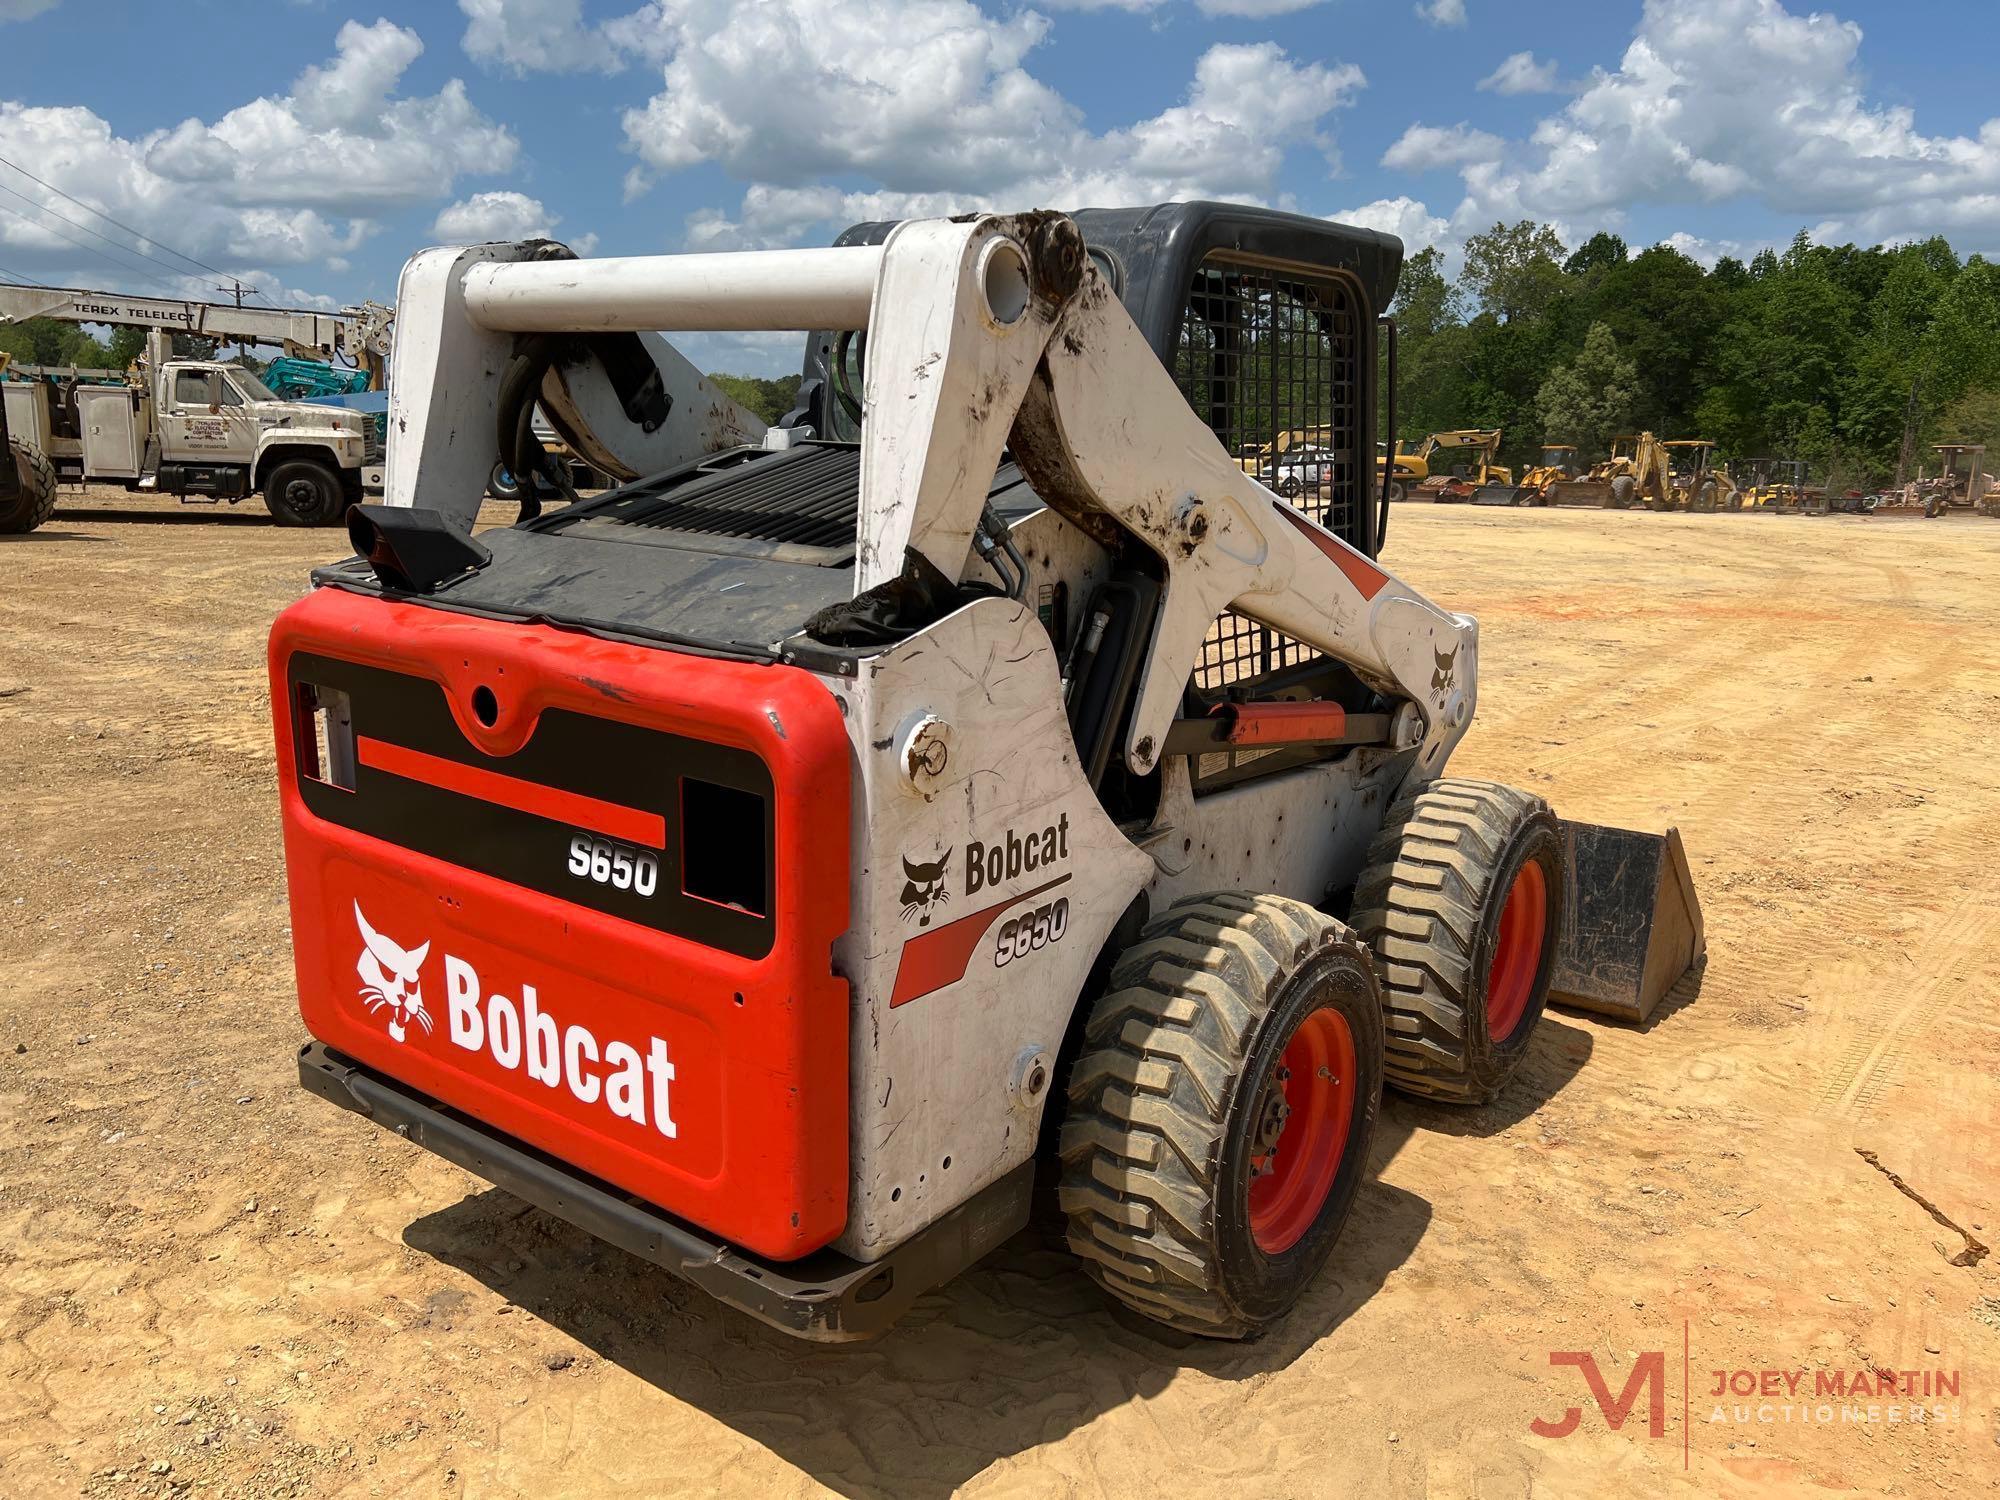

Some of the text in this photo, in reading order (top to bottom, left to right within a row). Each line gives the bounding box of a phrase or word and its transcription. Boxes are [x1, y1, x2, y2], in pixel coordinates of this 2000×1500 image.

[73, 303, 195, 322] TEREX TELELECT
[568, 831, 659, 897] S650
[966, 812, 1069, 896] Bobcat
[995, 896, 1069, 968] S650
[445, 953, 677, 1139] Bobcat
